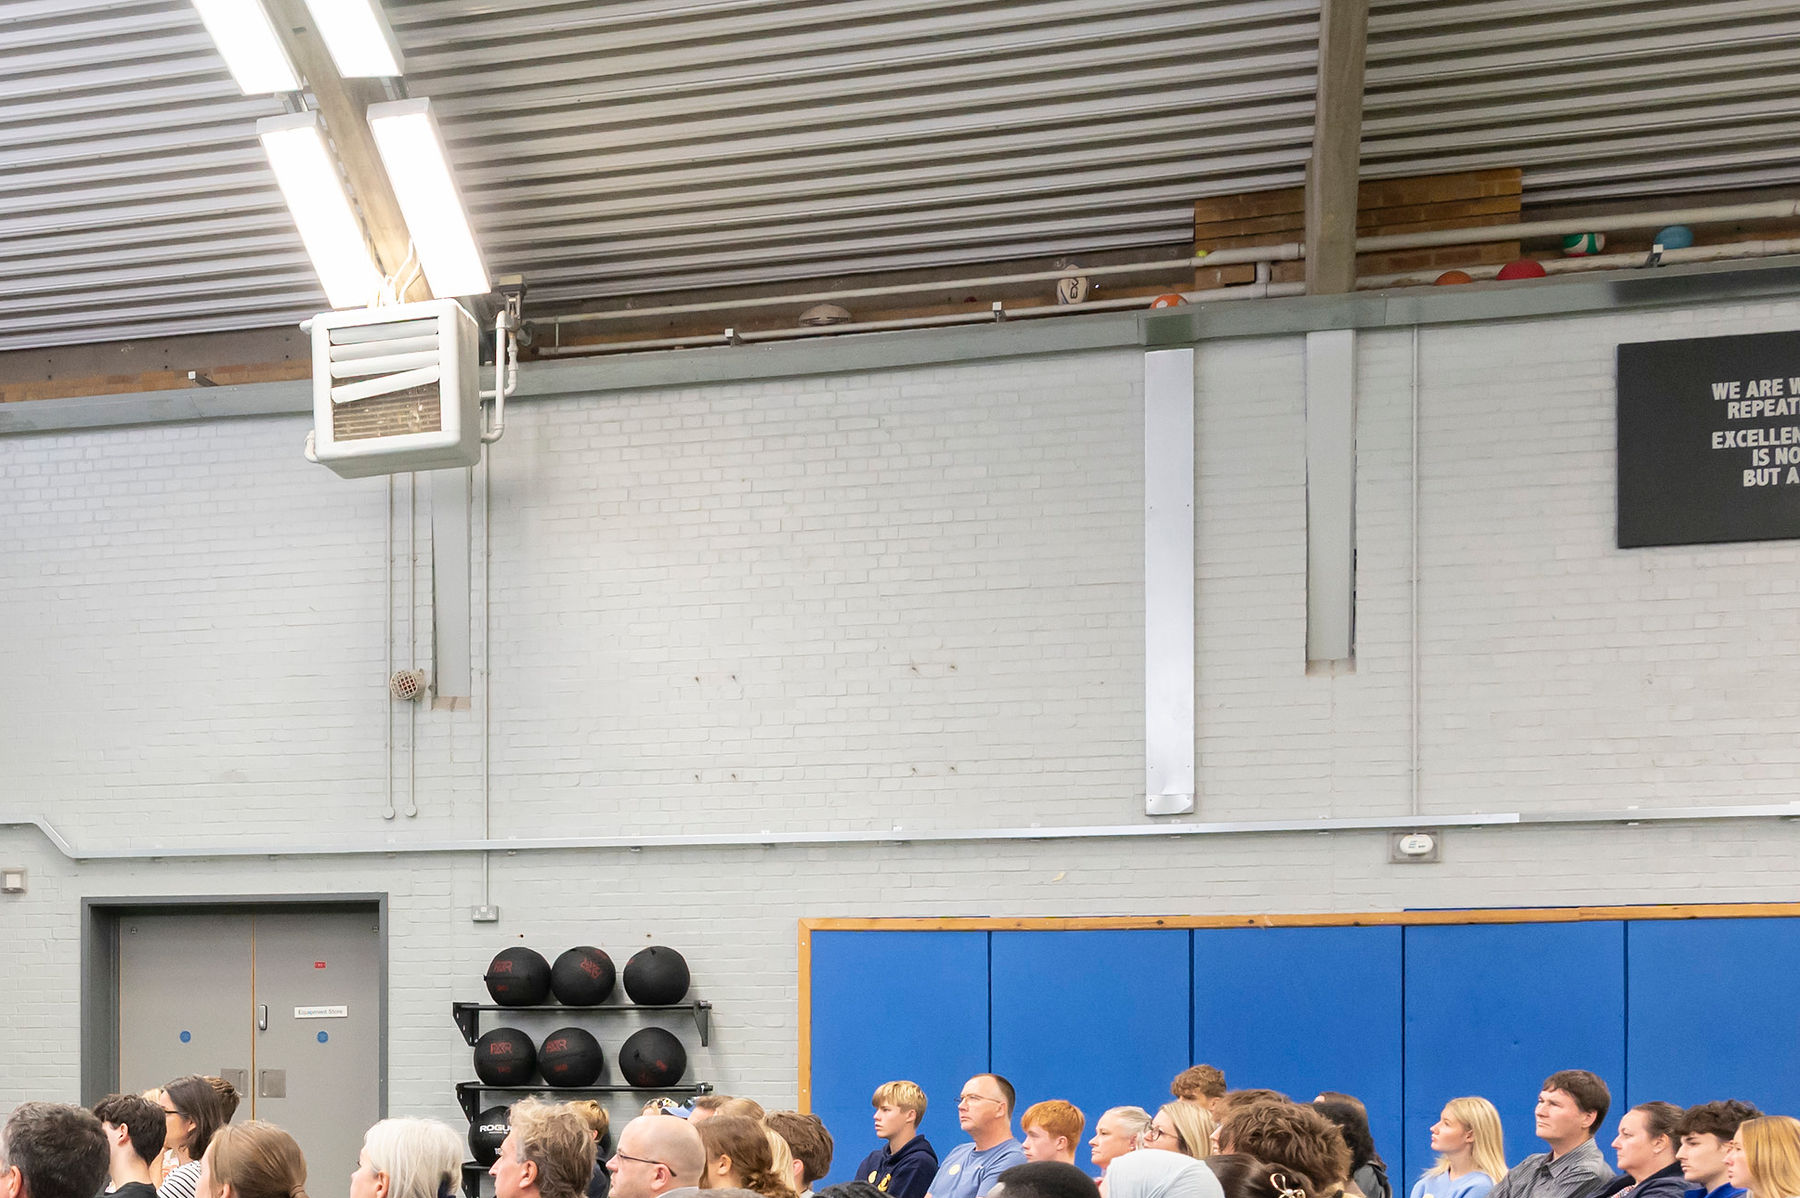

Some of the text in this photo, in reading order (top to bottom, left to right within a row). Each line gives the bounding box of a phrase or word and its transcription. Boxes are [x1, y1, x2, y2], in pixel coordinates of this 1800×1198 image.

[1711, 381, 1740, 400] WE
[1745, 378, 1783, 398] ARE
[1752, 448, 1770, 467] IS
[1743, 468, 1781, 487] BUT
[480, 1124, 513, 1132] ROGU
